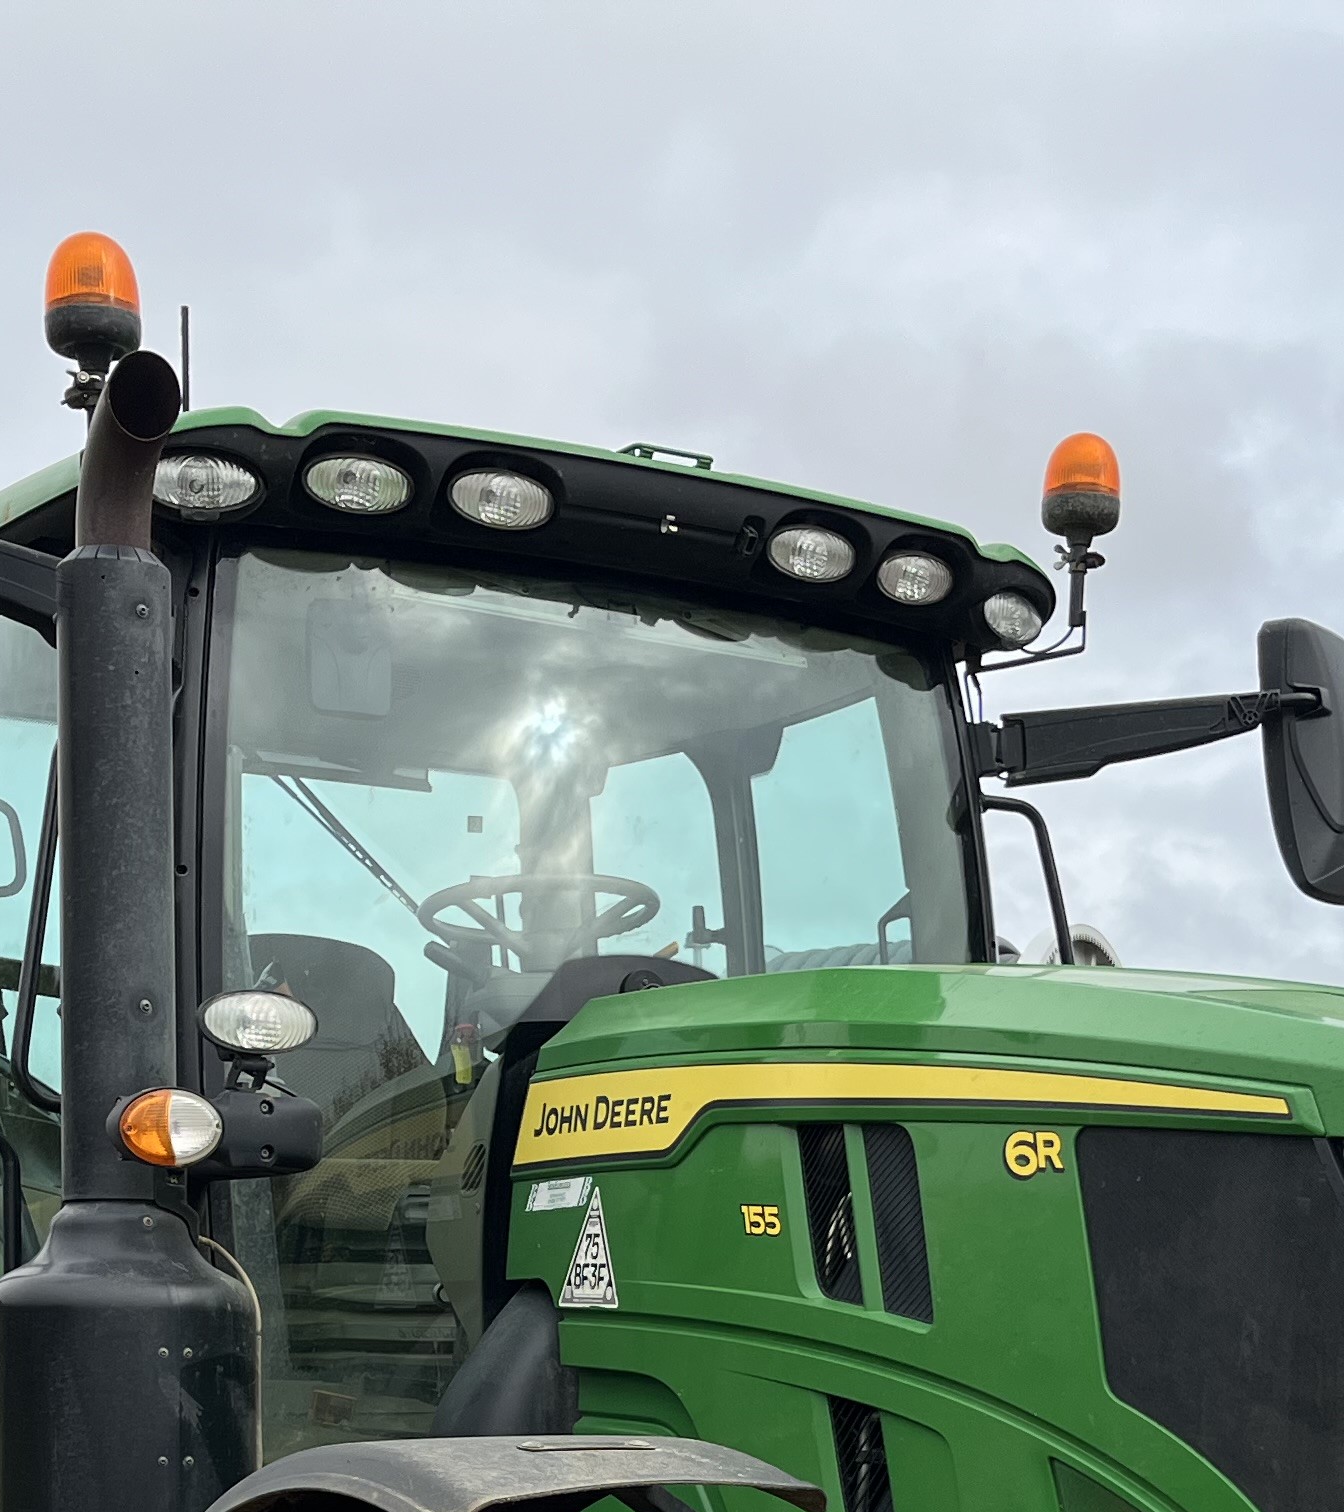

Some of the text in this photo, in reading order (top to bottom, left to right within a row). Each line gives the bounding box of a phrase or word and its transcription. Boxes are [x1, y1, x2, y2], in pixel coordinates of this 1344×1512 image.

[533, 1093, 672, 1138] JOHN DEERE
[1004, 1130, 1065, 1180] 6R
[740, 1204, 782, 1237] 155
[584, 1233, 601, 1260] 75
